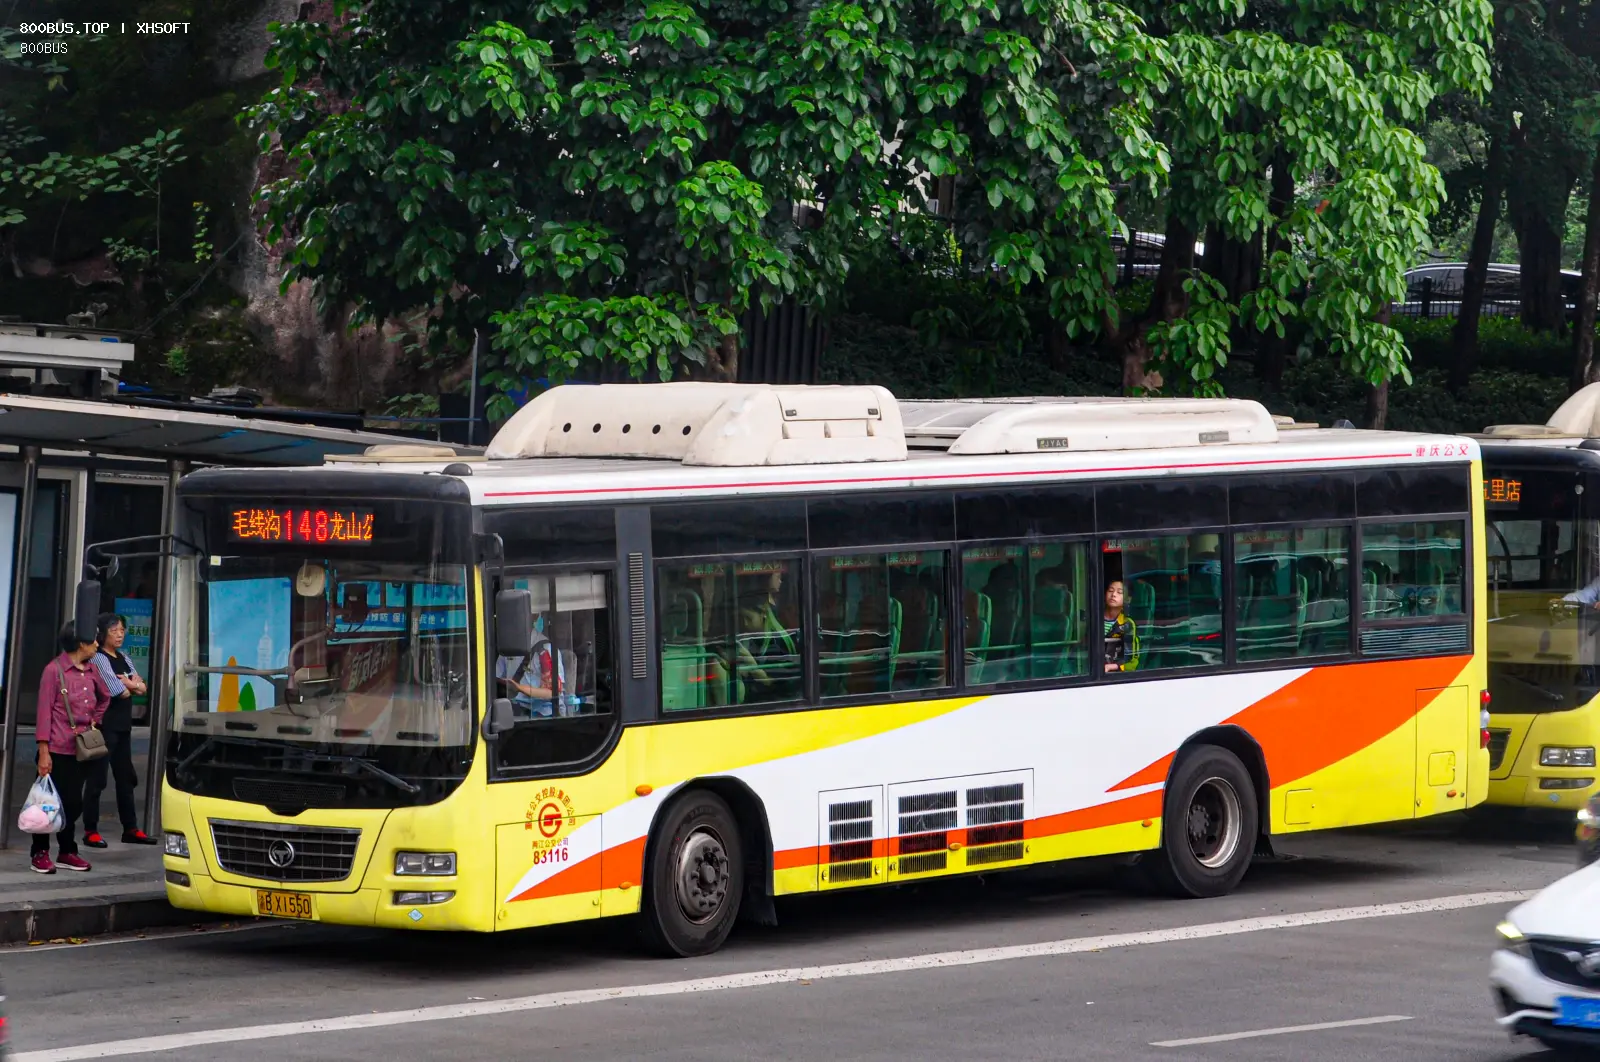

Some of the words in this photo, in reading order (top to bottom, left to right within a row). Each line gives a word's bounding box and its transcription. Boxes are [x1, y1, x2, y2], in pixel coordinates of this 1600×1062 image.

[1415, 444, 1469, 457] 重庆公交
[232, 509, 281, 540] 毛线沟
[284, 510, 329, 542] 148
[533, 847, 569, 866] 83116
